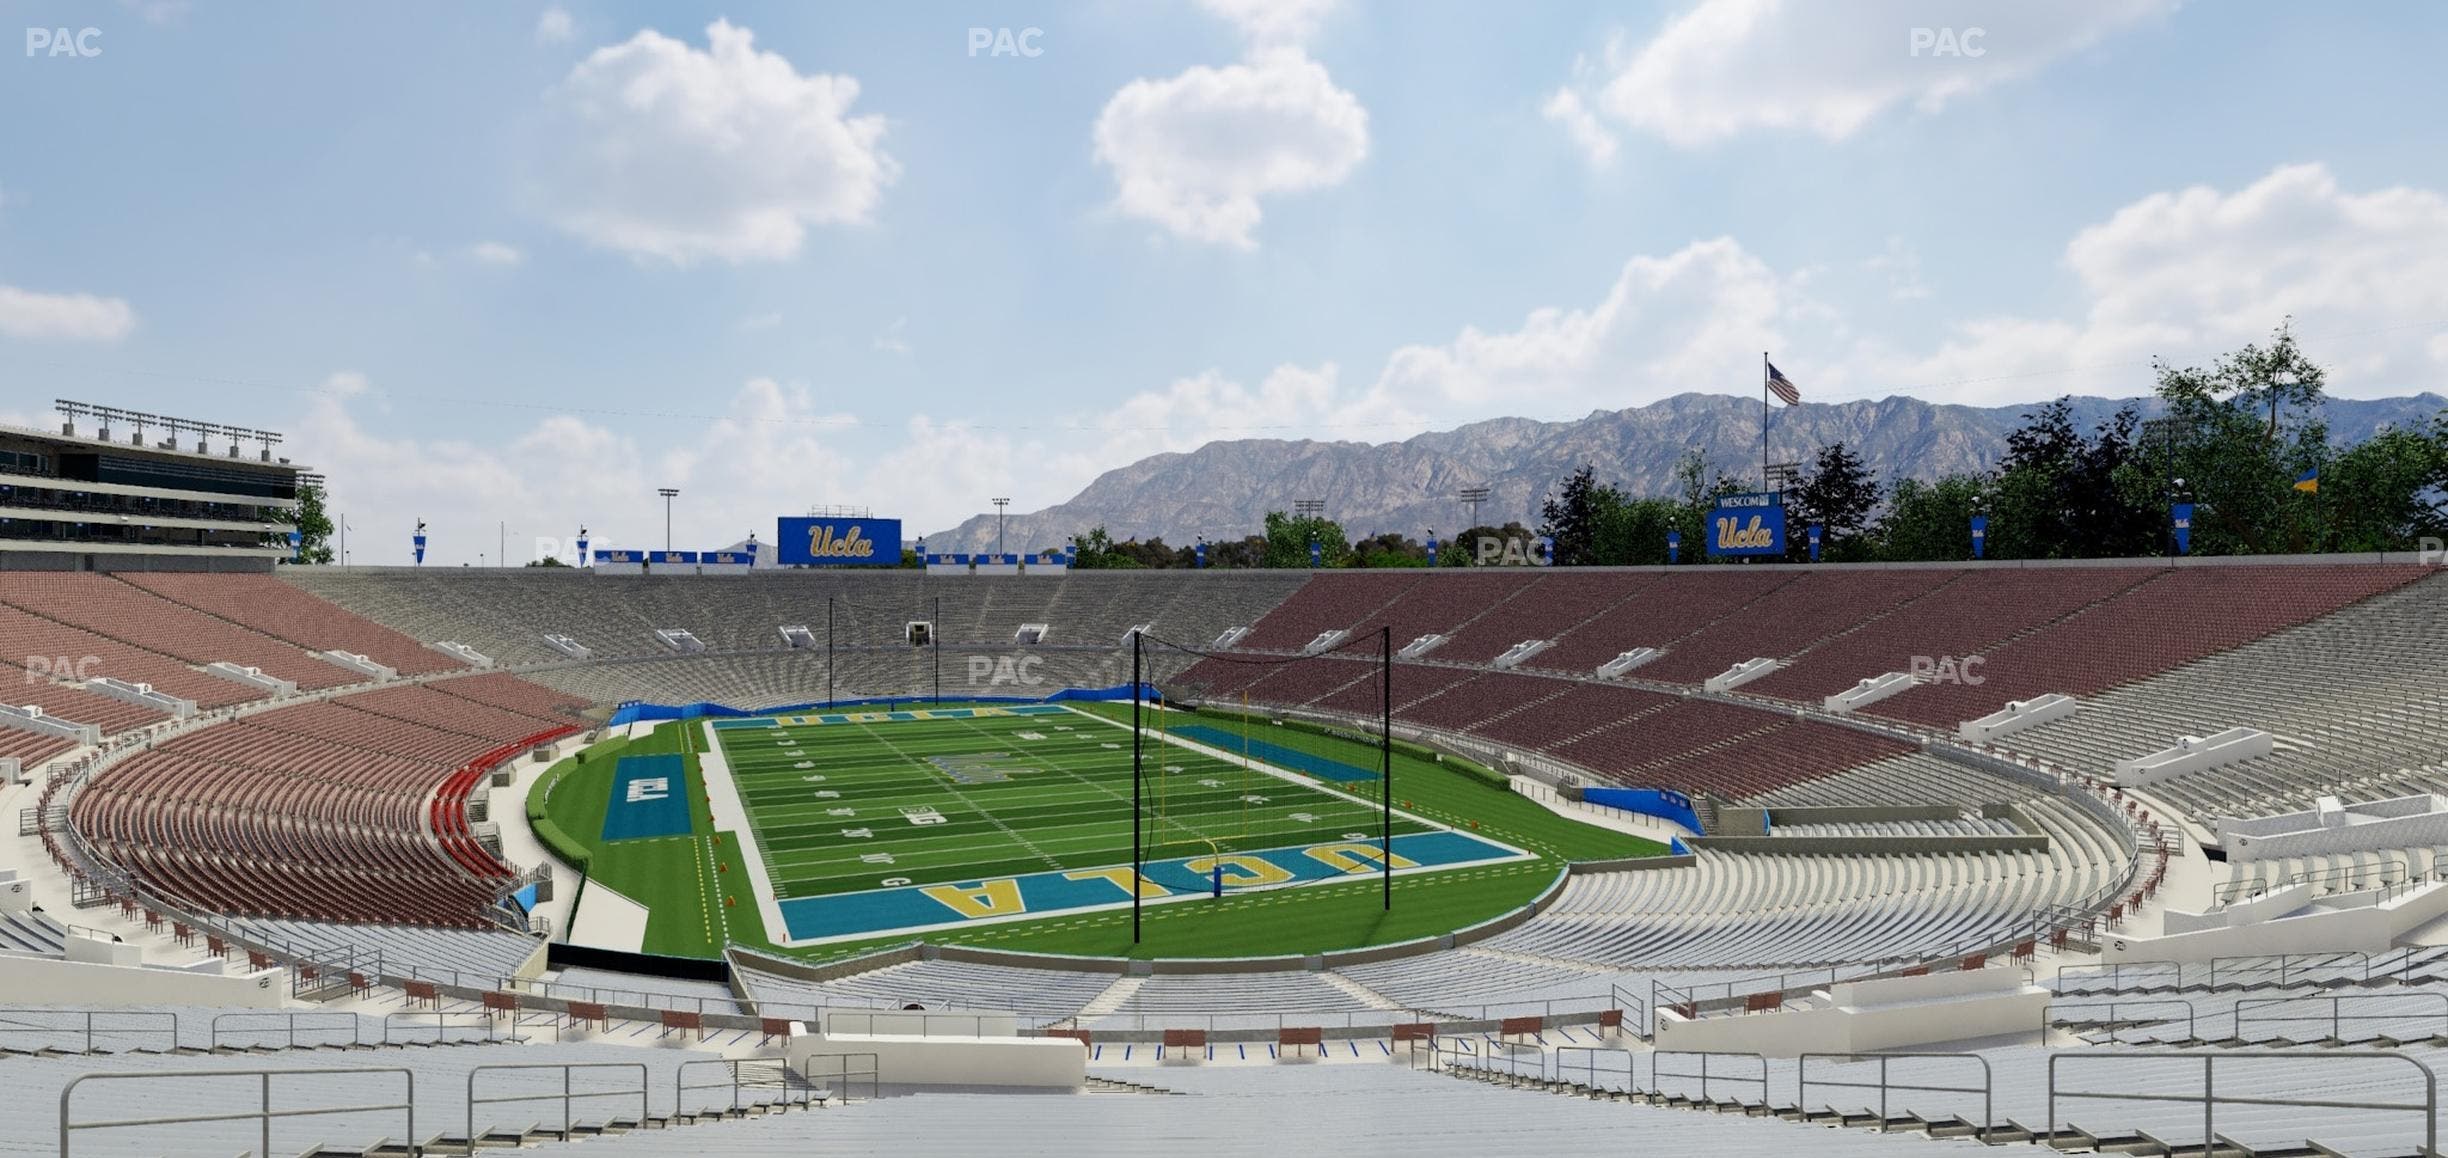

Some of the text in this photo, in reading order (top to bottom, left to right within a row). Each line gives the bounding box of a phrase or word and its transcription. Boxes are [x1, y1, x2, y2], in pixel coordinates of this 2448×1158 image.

[1720, 496, 1760, 508] WESCOM
[808, 525, 874, 557] Ucla
[918, 843, 1421, 919] UCLA
